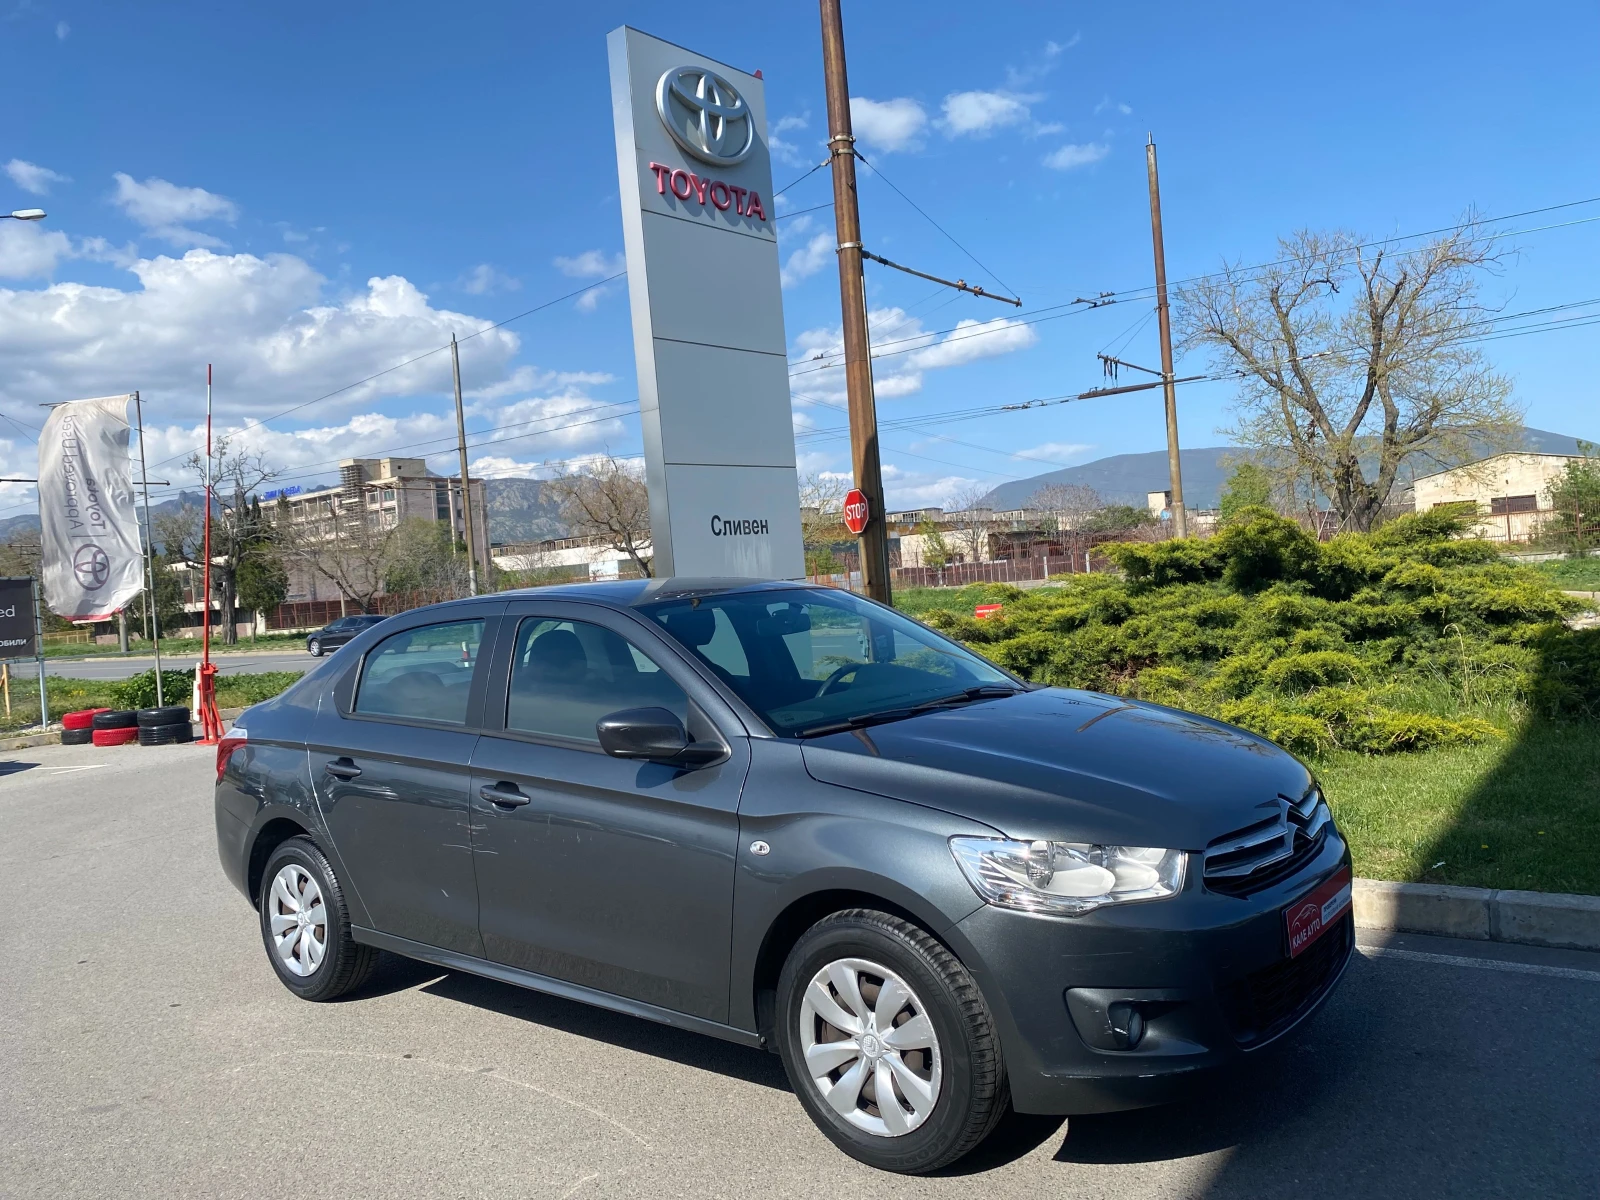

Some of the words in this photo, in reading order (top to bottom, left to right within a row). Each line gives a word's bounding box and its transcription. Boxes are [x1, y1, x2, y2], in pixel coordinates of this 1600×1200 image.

[650, 161, 766, 221] TOYOTA
[846, 503, 867, 521] STOP
[710, 514, 769, 536] Сливен
